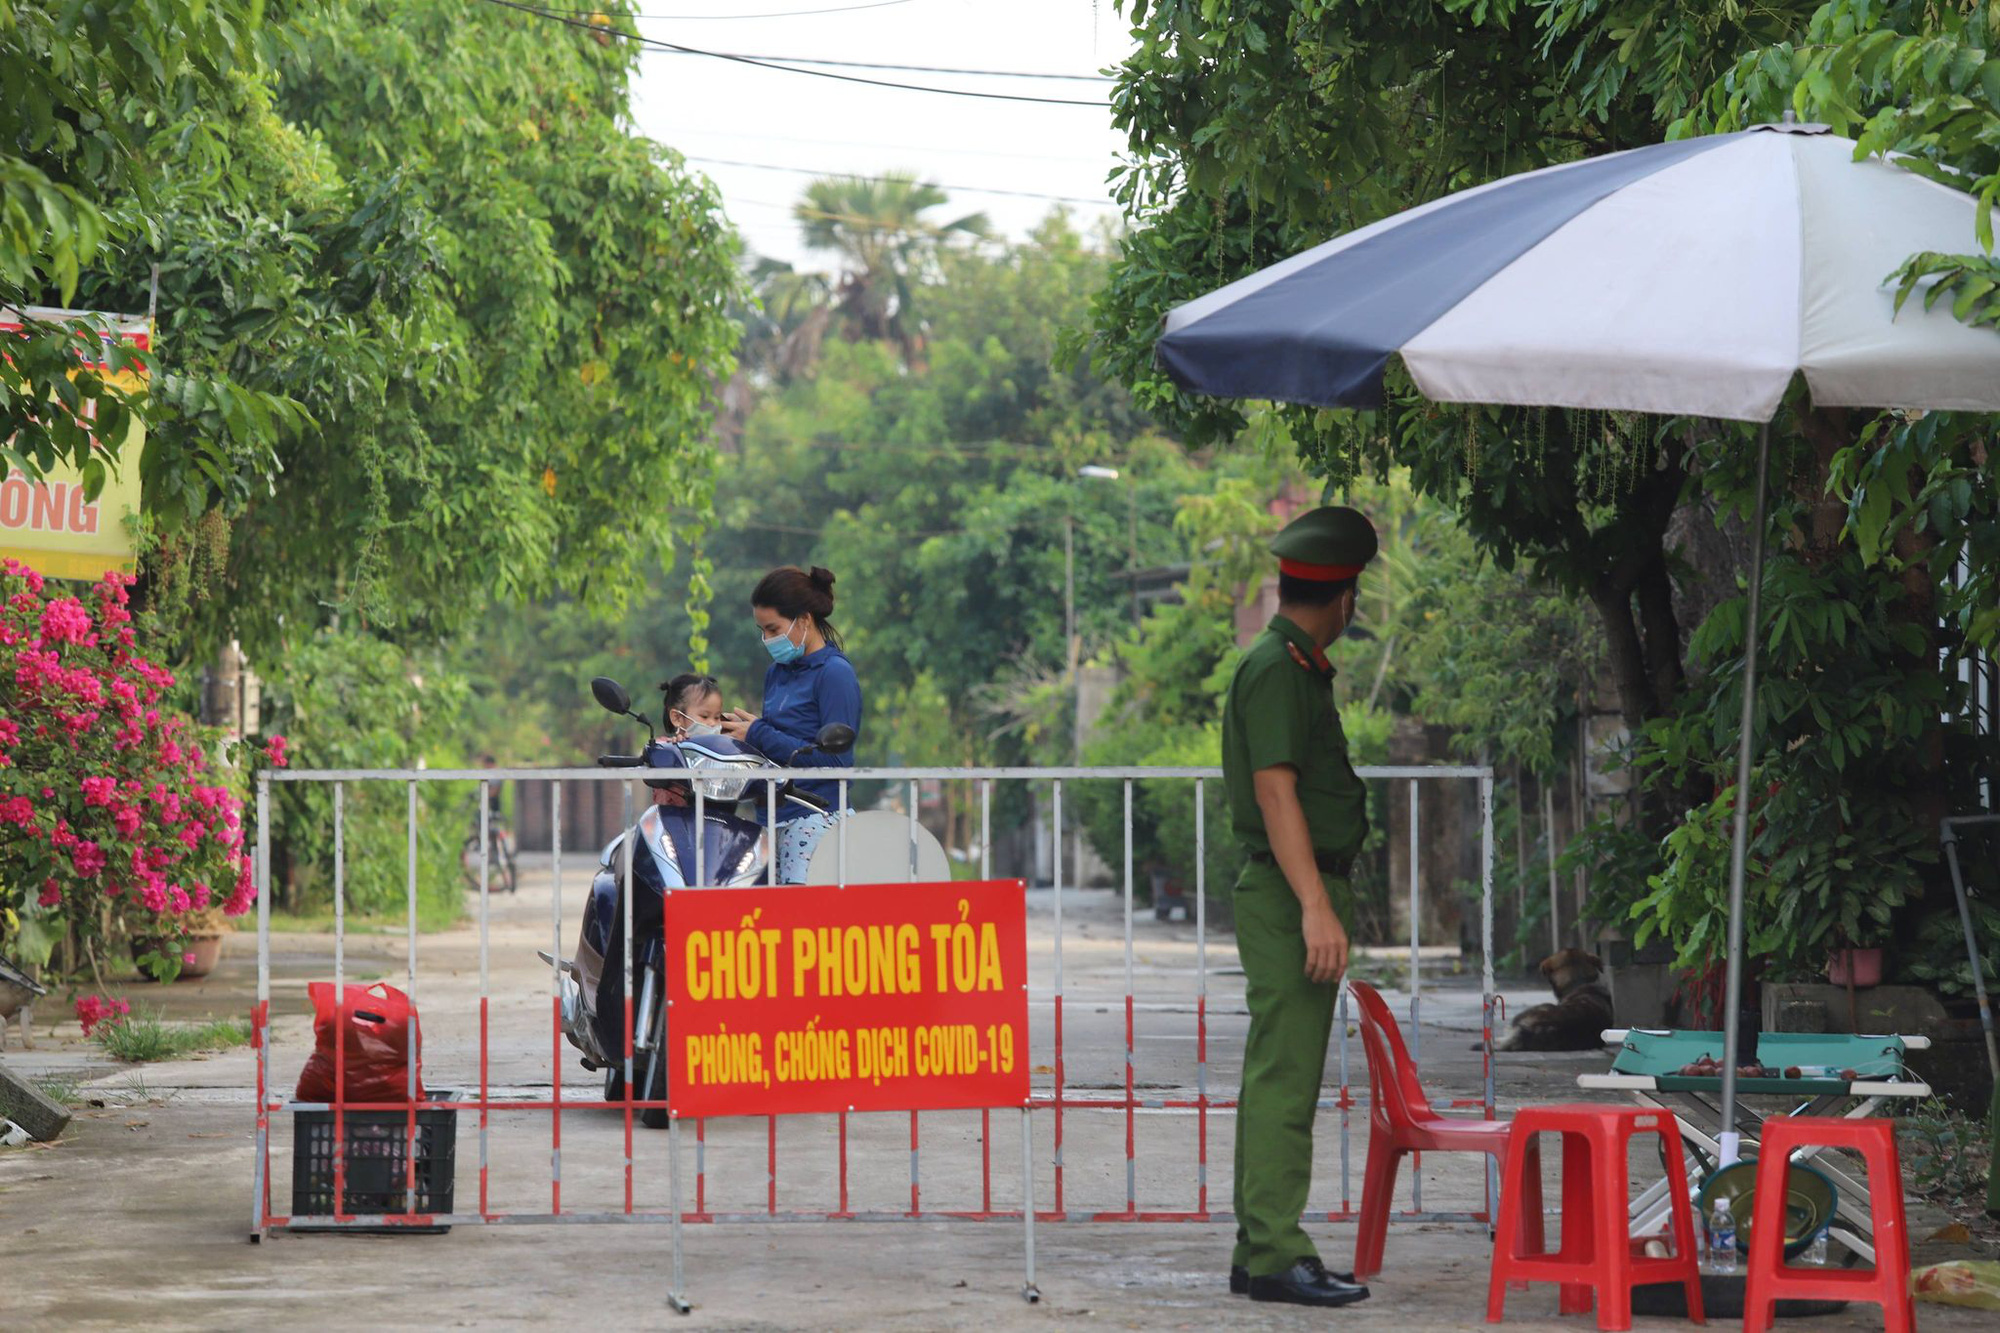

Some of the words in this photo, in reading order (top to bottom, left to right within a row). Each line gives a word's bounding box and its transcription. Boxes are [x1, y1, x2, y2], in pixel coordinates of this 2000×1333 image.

[685, 907, 781, 1001] CHỐT
[793, 923, 921, 997] PHONG
[930, 898, 1003, 993] TỎA
[686, 1022, 770, 1089] PHÒNG,
[775, 1015, 851, 1082] CHỐNG
[856, 1027, 909, 1086] DỊCH
[914, 1023, 1014, 1076] COVID-19
